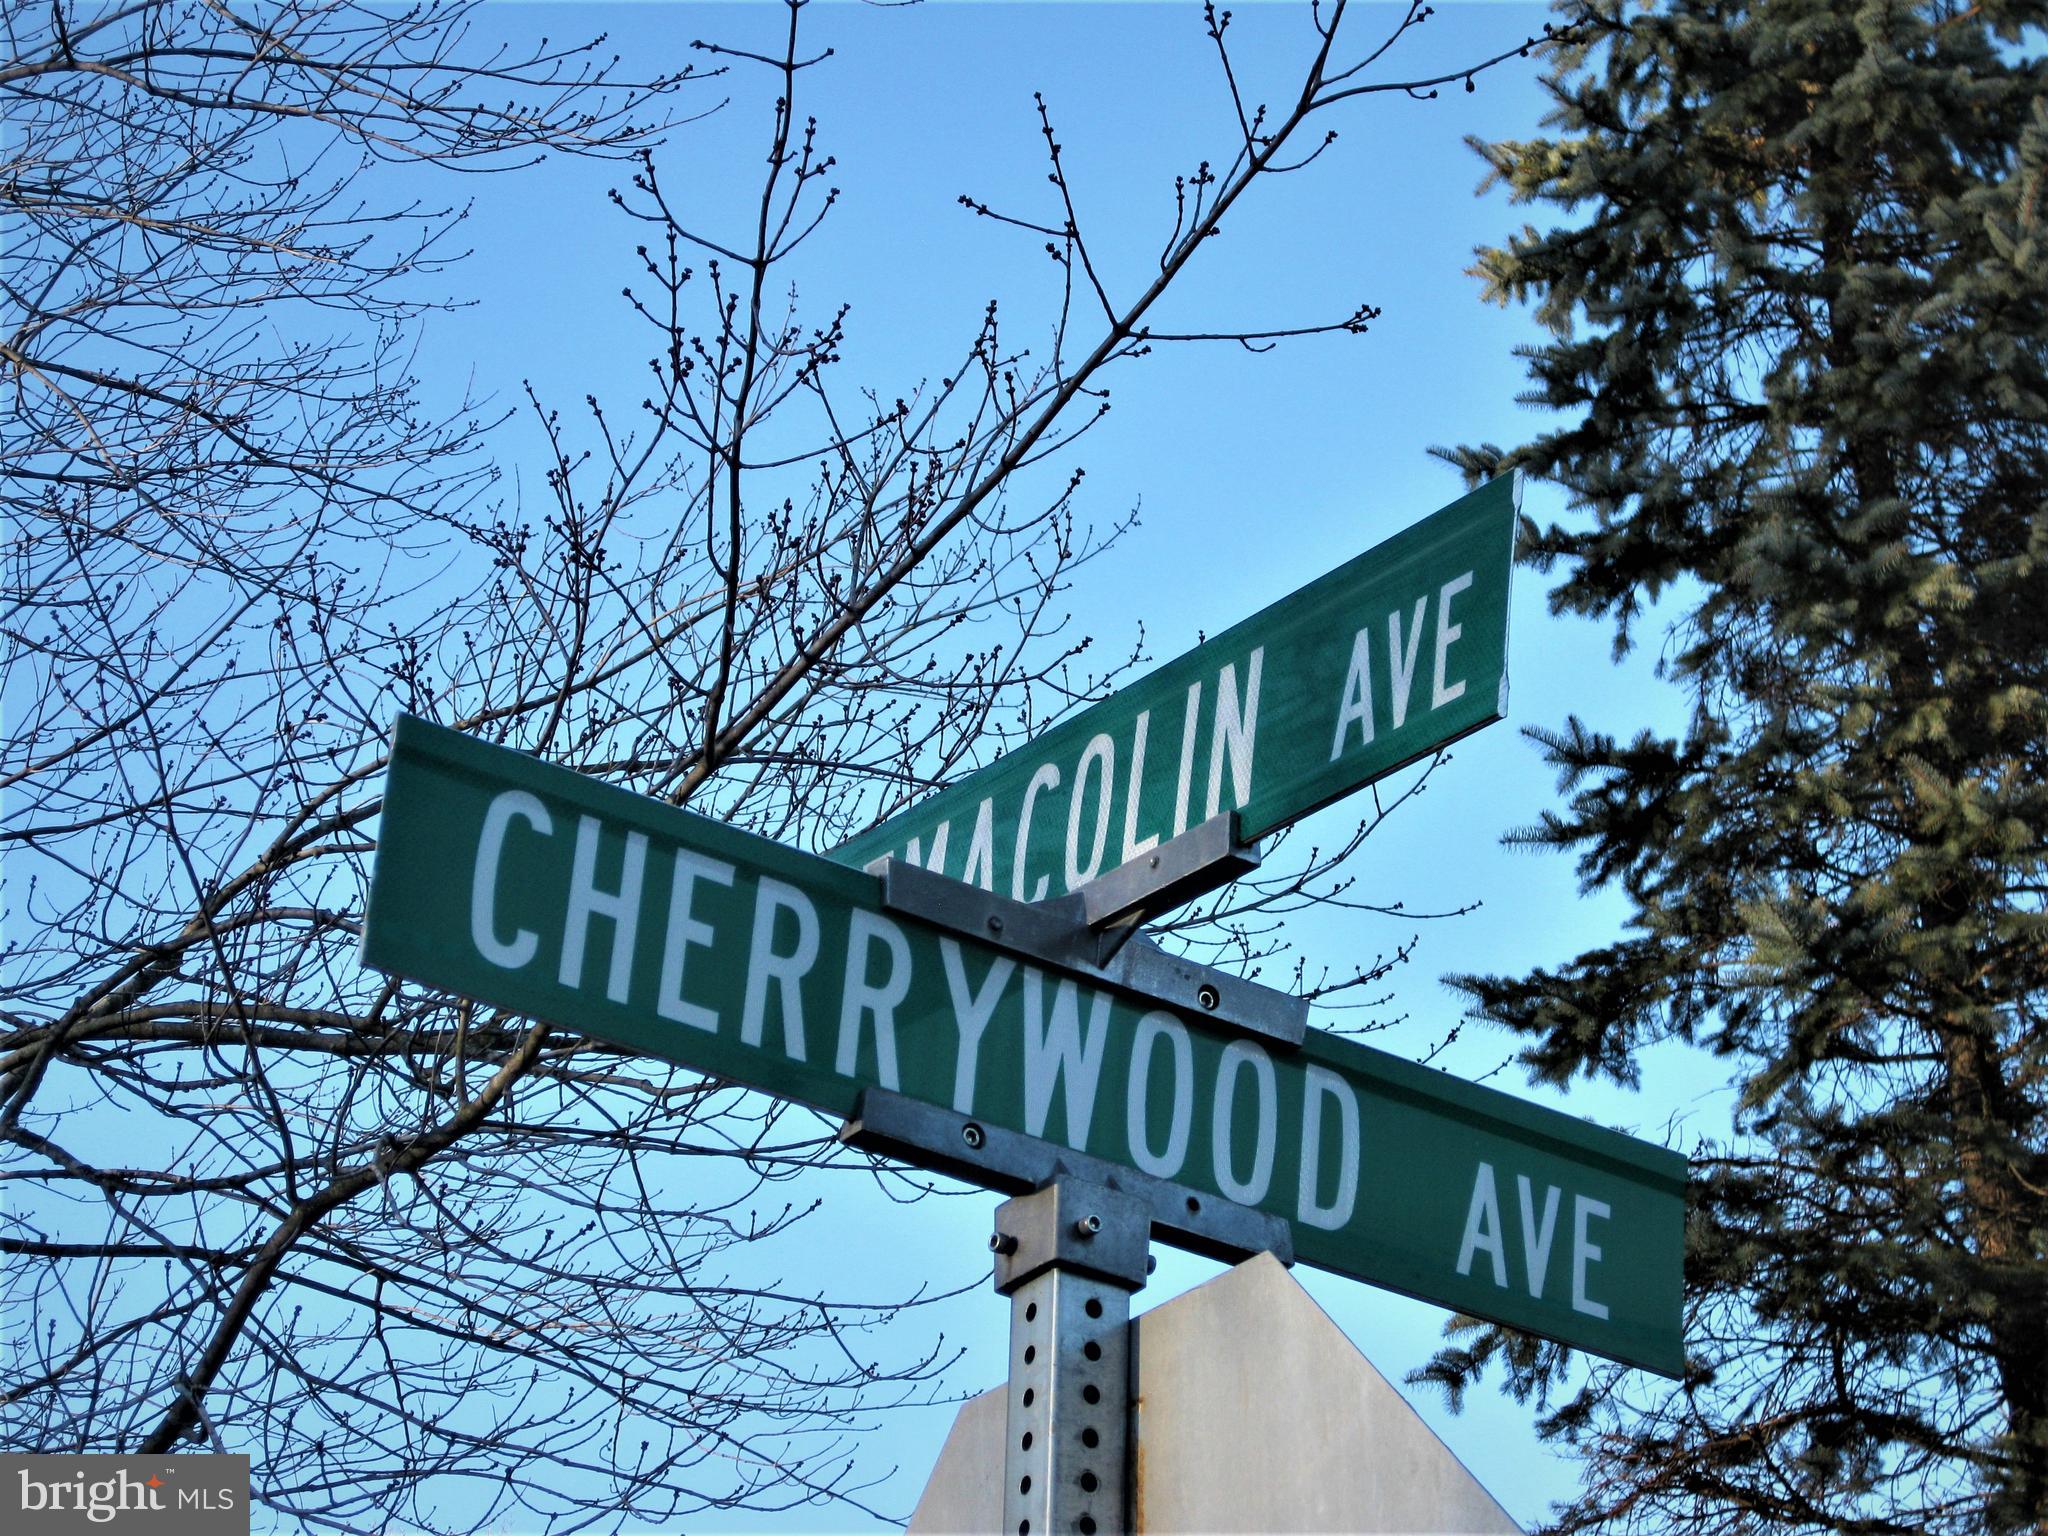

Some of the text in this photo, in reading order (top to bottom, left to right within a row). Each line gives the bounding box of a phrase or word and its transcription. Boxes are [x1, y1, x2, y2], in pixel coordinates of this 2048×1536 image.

[1330, 571, 1473, 762] AVE
[471, 790, 1611, 1321] CHERRYWOOD AVE
